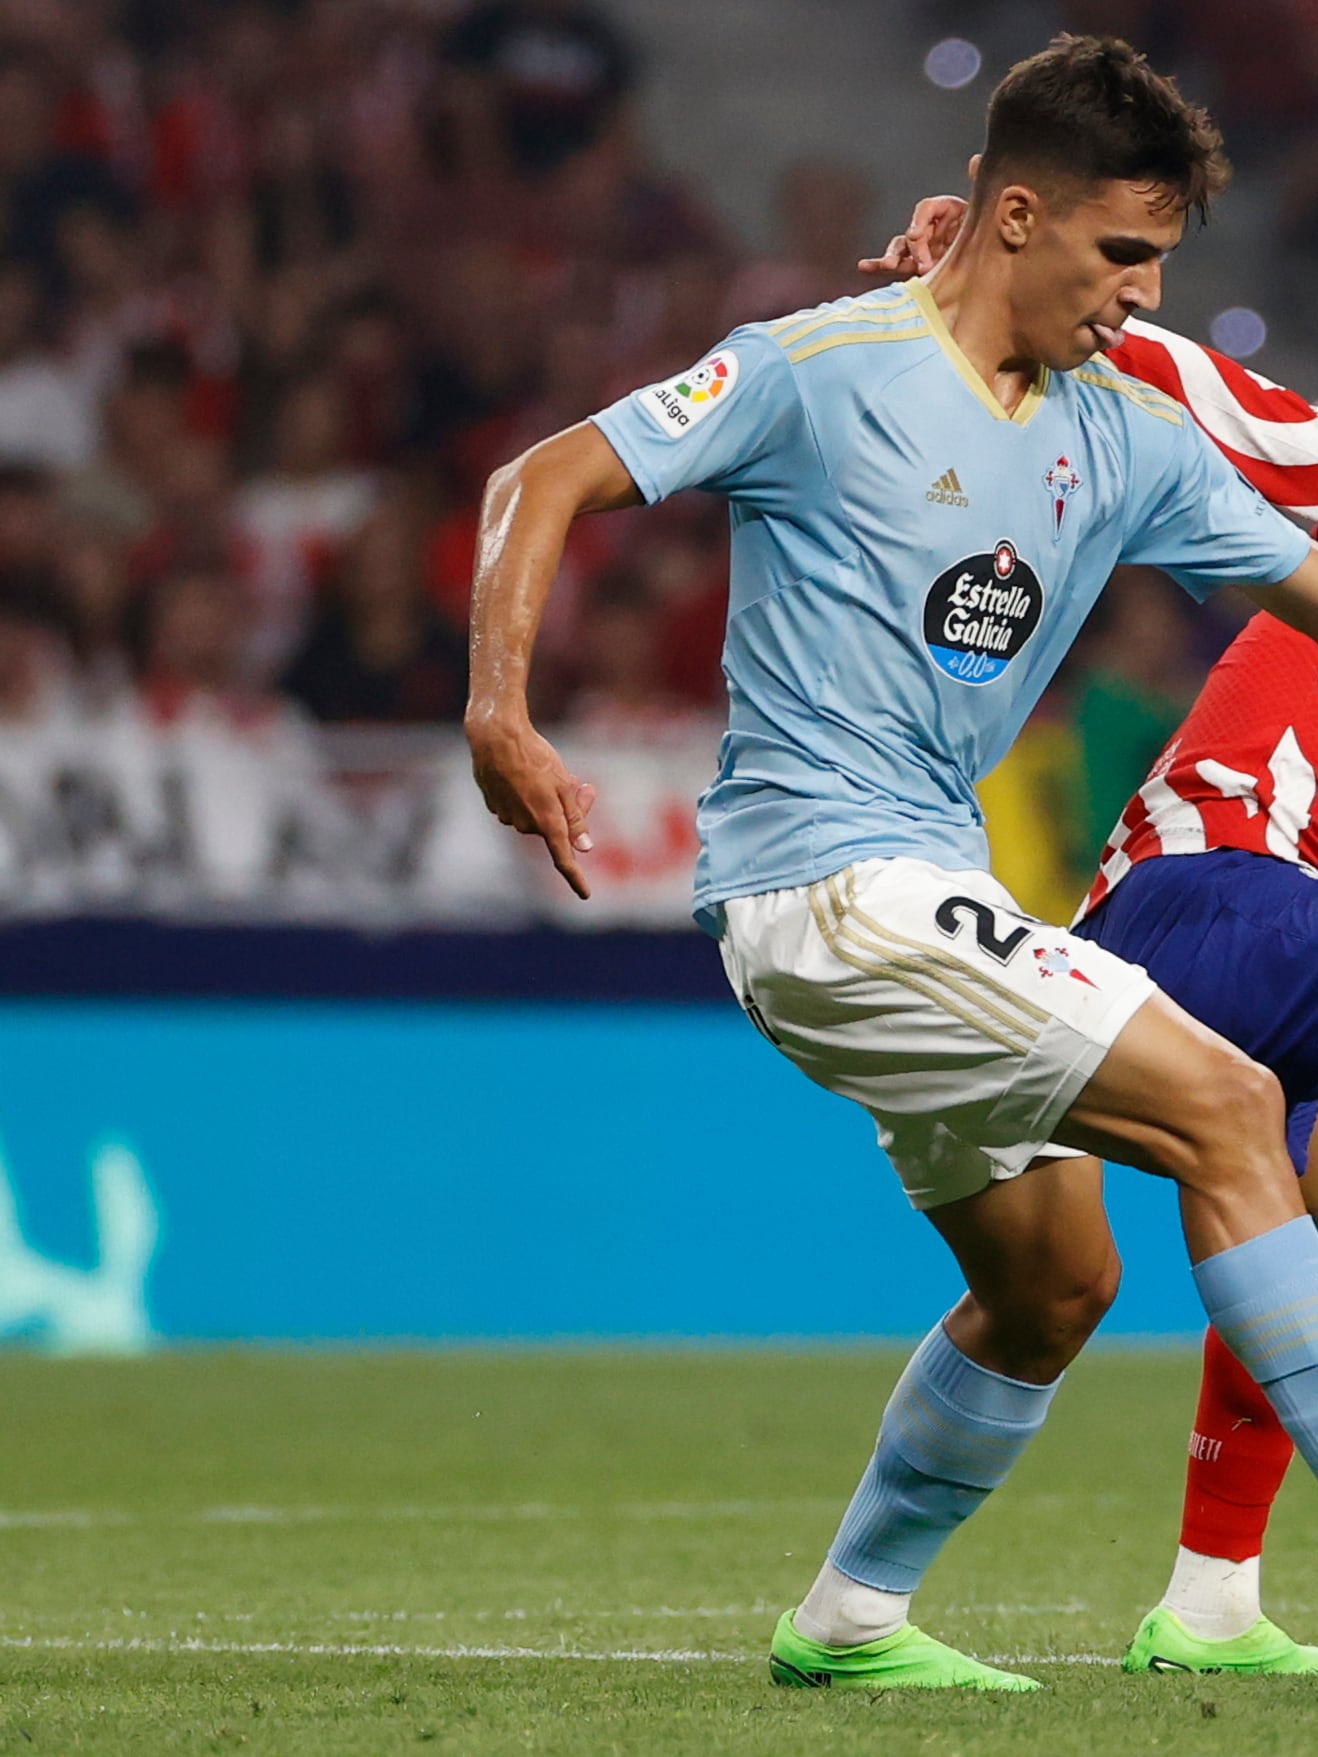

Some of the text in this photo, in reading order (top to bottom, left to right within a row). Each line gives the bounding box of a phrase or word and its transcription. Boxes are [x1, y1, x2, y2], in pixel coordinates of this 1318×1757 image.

[653, 389, 690, 426] aLiga
[926, 488, 969, 508] adidas
[947, 572, 1032, 620] Estrella
[943, 607, 1014, 652] Galicia
